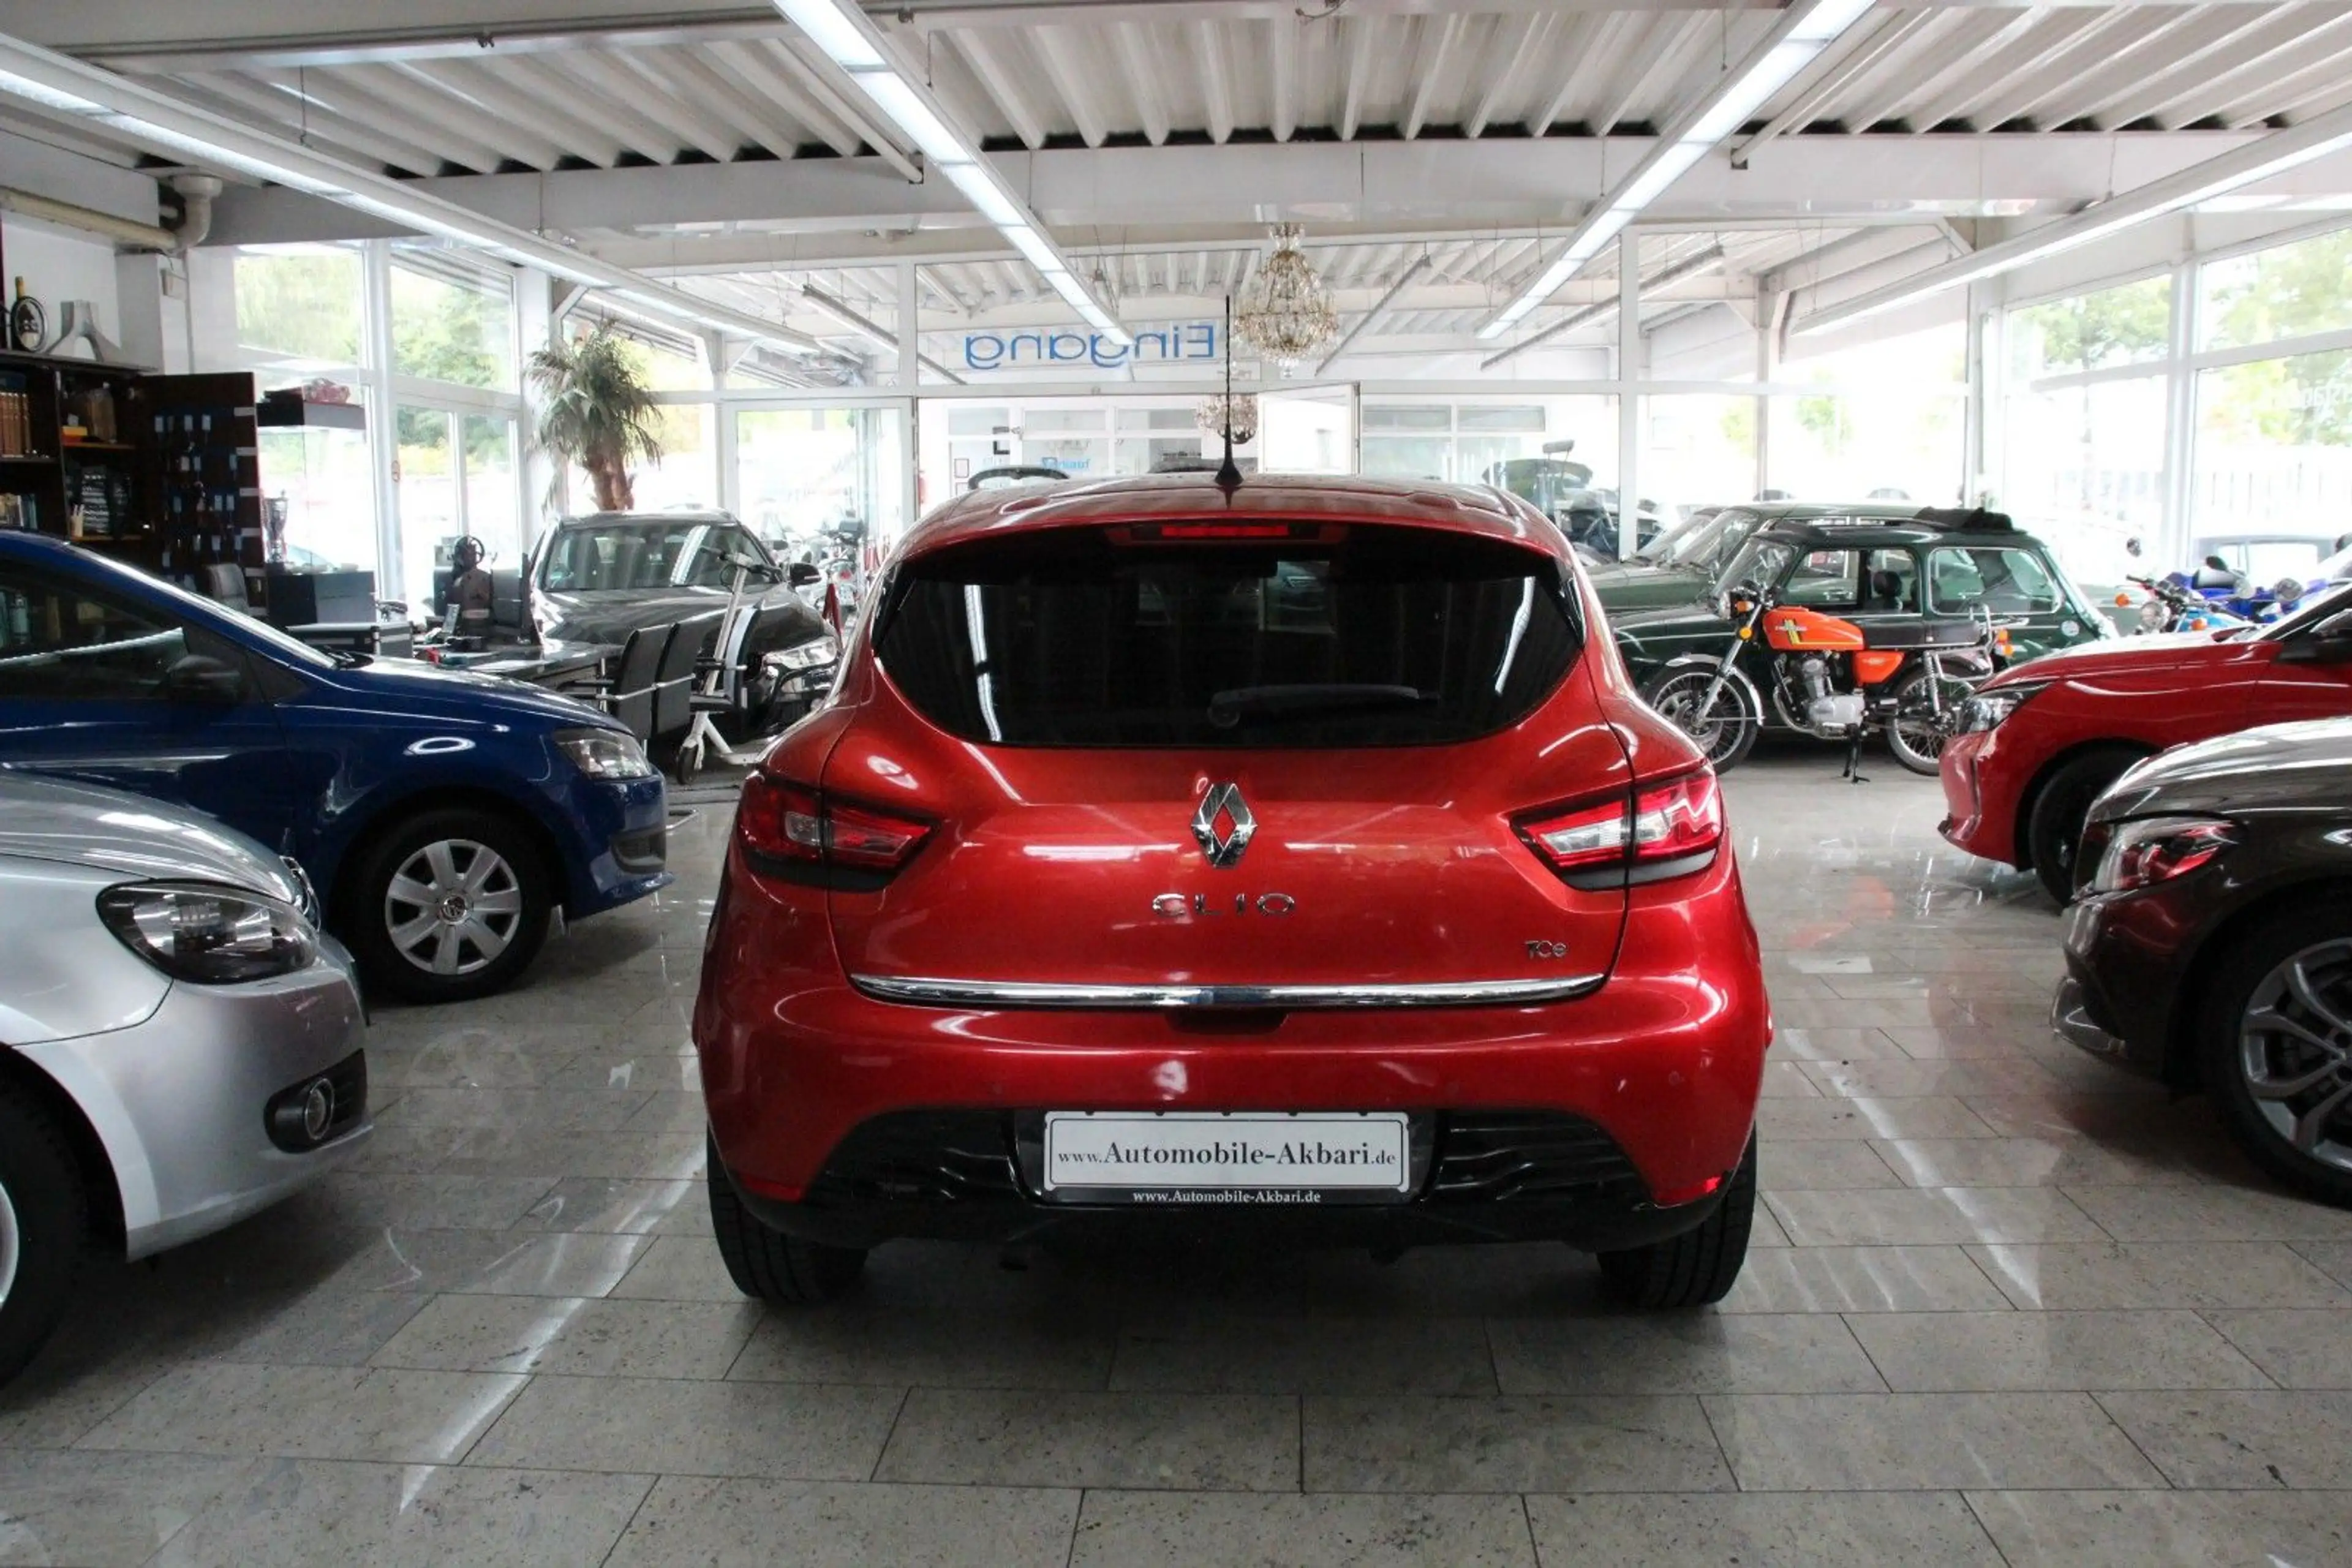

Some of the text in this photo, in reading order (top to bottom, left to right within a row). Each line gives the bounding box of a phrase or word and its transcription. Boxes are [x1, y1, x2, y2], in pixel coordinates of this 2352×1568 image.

[1152, 893, 1295, 917] CLIO
[1058, 1142, 1396, 1165] www.Automobile-Akbari.de
[1133, 1189, 1321, 1204] www.Automobile-Akbari.de
